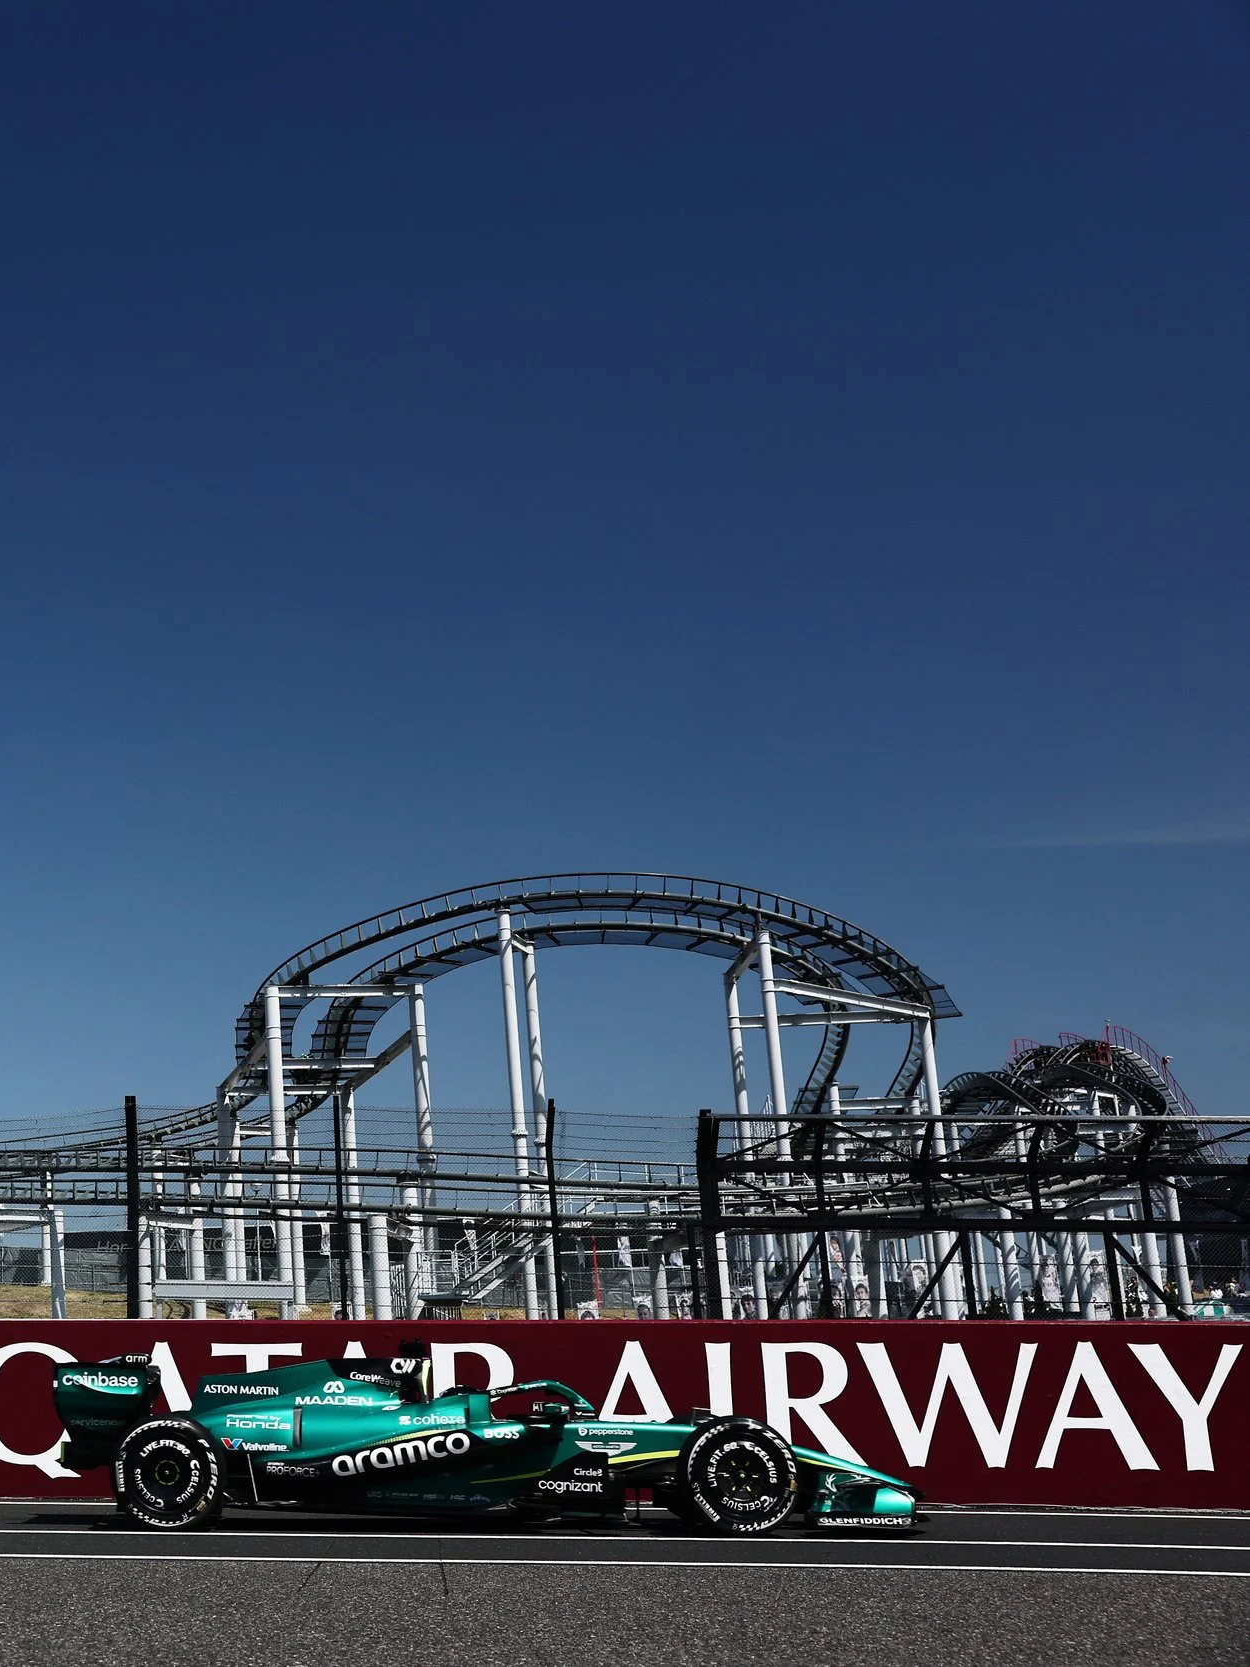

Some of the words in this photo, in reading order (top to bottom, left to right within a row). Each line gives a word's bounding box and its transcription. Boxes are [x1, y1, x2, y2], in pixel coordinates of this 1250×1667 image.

[125, 1355, 148, 1363] arm
[62, 1372, 139, 1387] coinbase
[350, 1371, 402, 1388] CoreWeave
[203, 1384, 238, 1395] ASTON
[239, 1386, 279, 1396] MARTIN
[295, 1395, 373, 1407] MAADEN
[226, 1419, 292, 1430] Honda
[483, 1428, 520, 1440] BOSS
[332, 1432, 471, 1477] aramco
[206, 1451, 219, 1500] ZERO
[538, 1480, 603, 1494] cognizant
[818, 1517, 904, 1526] GLENFIDDICH
